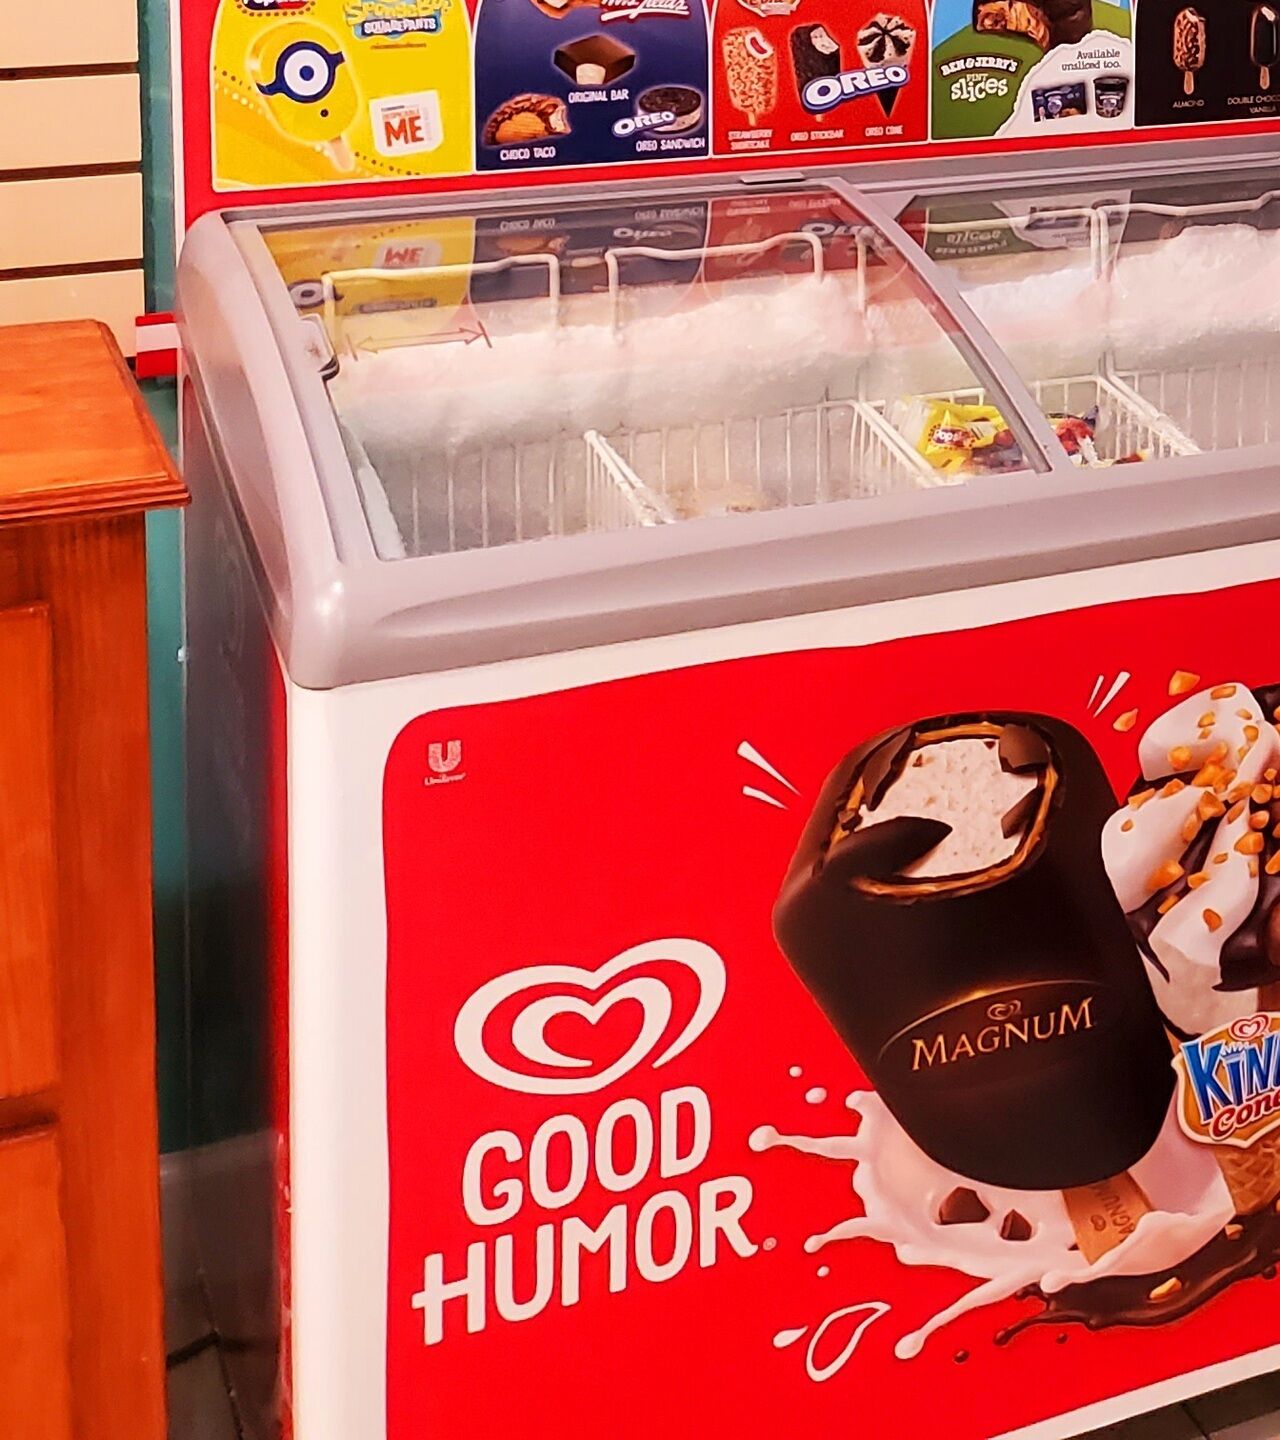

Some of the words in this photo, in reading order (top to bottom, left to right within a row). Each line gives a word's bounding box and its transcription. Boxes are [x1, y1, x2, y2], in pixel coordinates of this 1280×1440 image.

[364, 18, 436, 34] SQUAREPANTS
[1077, 49, 1120, 60] Available
[974, 56, 1018, 72] JERRY'S
[1062, 61, 1100, 71] unsliced
[1104, 60, 1121, 69] too.
[806, 67, 906, 105] OREO
[951, 77, 1008, 101] slices
[569, 92, 606, 103] ORIGINAL
[611, 89, 629, 101] BAR
[1173, 100, 1204, 108] ALMOND
[1228, 96, 1254, 105] DOUBLE
[614, 112, 674, 134] OREO
[384, 116, 424, 147] ME
[636, 140, 657, 151] OREO
[661, 137, 705, 150] SANDWICH
[500, 149, 530, 160] CHOCO
[534, 147, 555, 158] TACO
[910, 994, 1095, 1072] MAGNUM
[462, 1084, 712, 1227] GOOD
[412, 1174, 759, 1346] HUMOR
